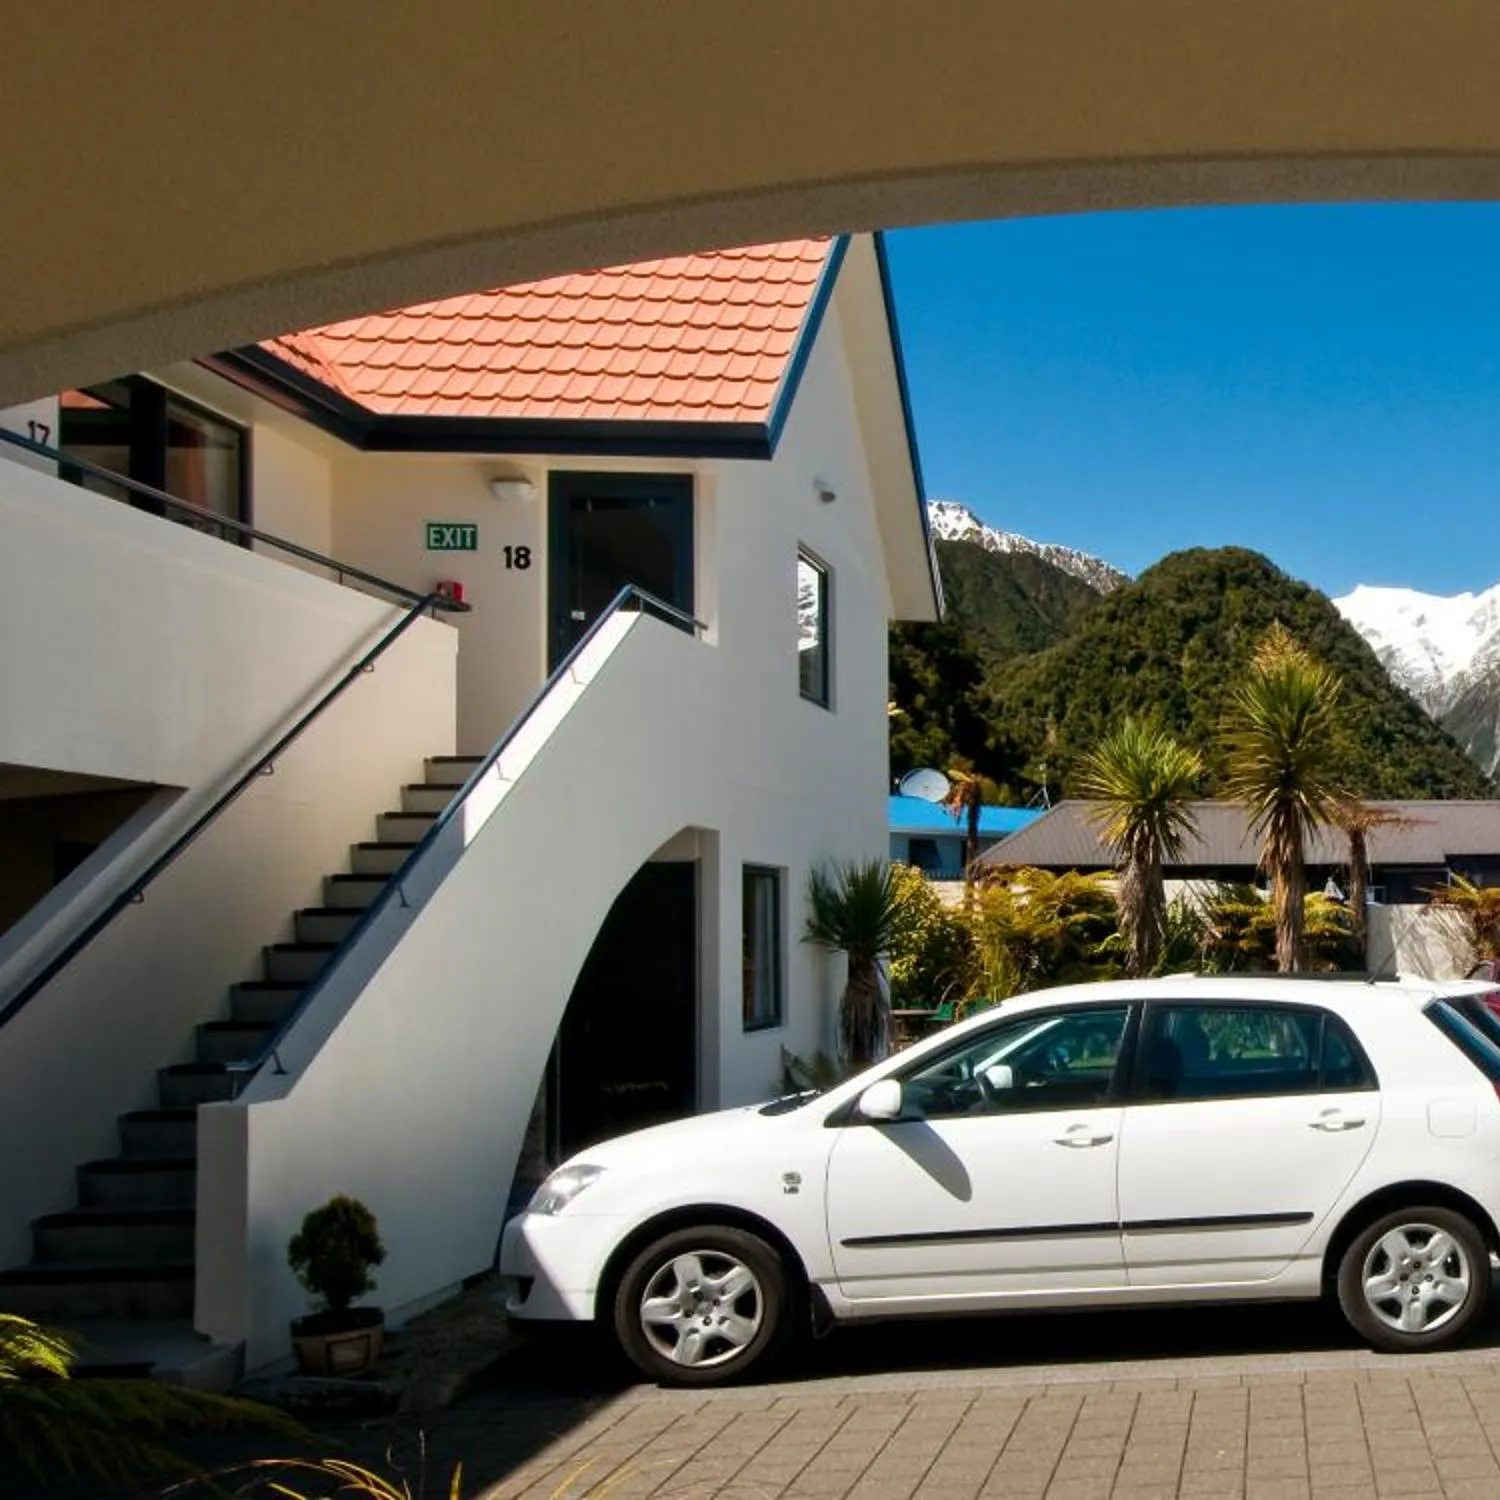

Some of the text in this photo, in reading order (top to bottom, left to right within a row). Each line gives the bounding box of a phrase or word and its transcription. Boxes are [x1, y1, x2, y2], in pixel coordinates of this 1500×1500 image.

[27, 420, 50, 445] 17
[429, 527, 475, 547] EXIT
[503, 545, 531, 570] 18
